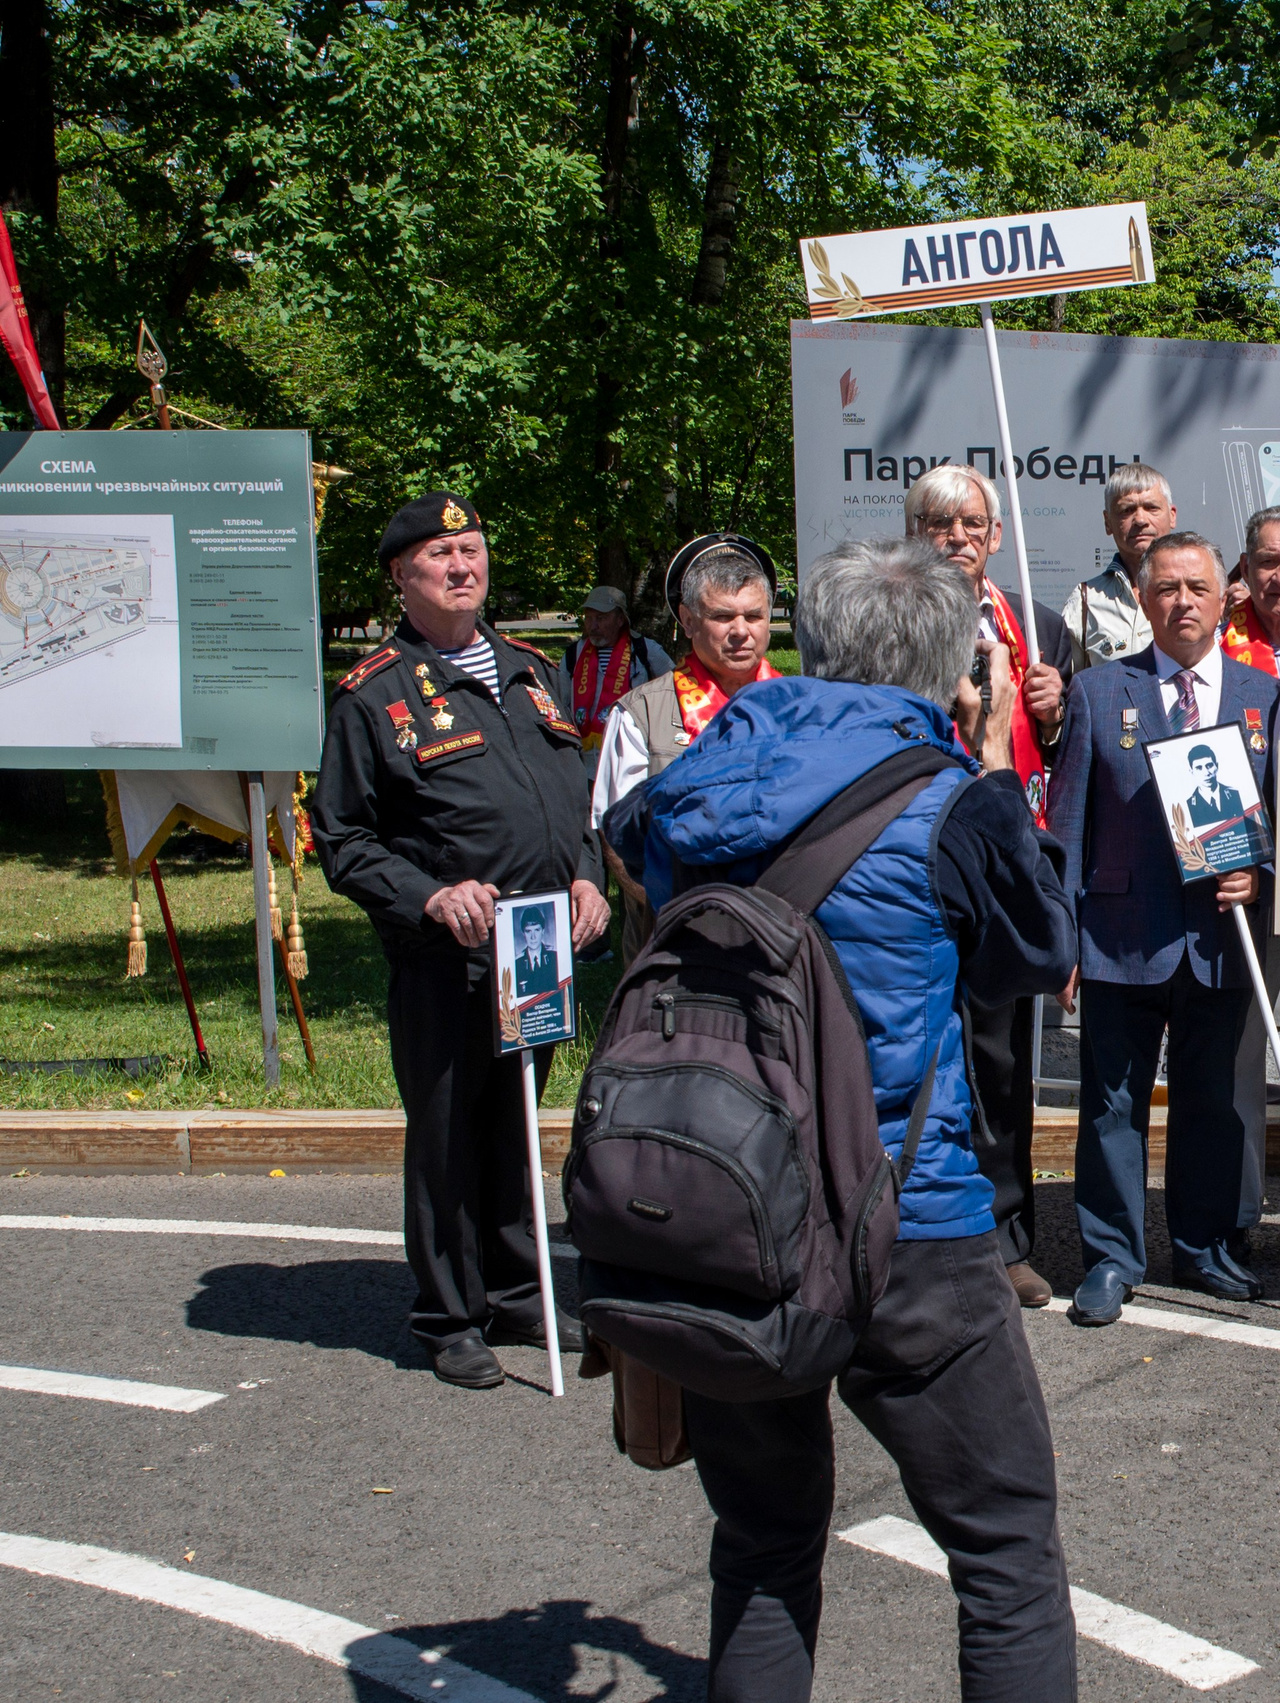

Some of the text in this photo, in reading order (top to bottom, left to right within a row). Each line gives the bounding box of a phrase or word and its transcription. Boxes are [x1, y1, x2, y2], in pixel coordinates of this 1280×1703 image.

[902, 223, 1065, 286] АНГОЛА
[40, 460, 97, 474] СХЕМА
[95, 480, 210, 496] чрезвычайных
[213, 479, 284, 495] ситуаций
[843, 495, 905, 505] НА ПОКЛО
[843, 508, 892, 518] VICTORY
[1033, 507, 1066, 517] GORA
[189, 528, 298, 536] аварийно-спасательных служб,
[420, 745, 444, 758] МОРСКАЯ
